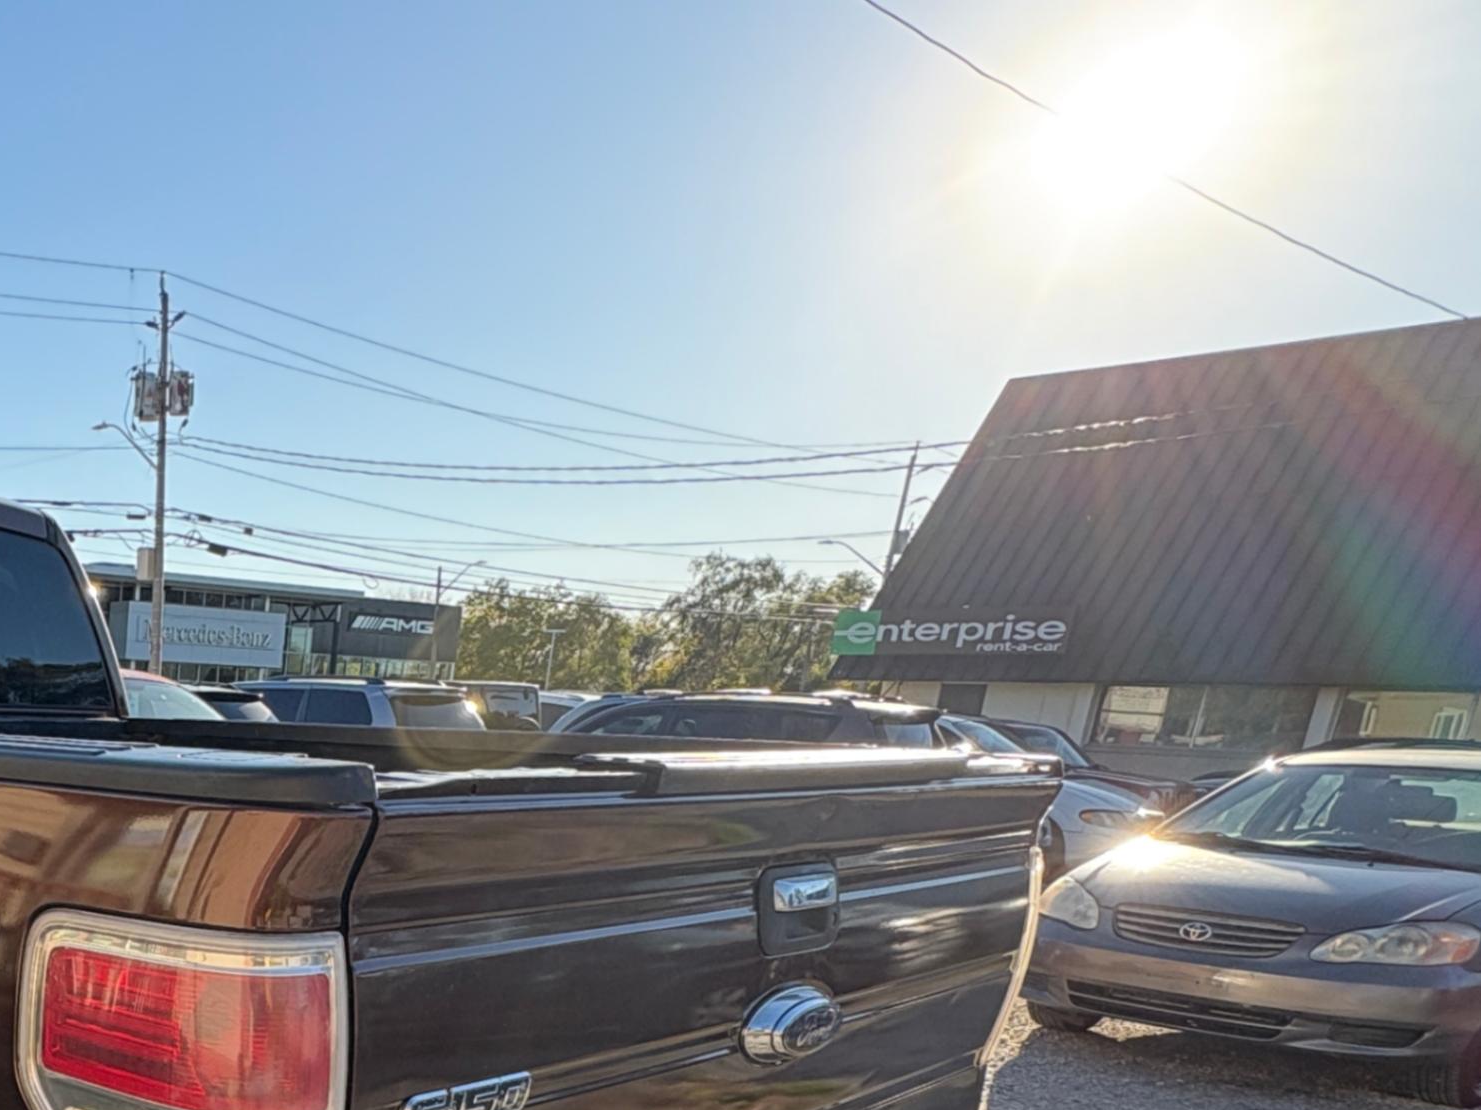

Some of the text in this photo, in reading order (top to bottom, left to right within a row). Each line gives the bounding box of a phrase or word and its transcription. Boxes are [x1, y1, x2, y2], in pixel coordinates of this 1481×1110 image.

[379, 617, 435, 635] AMG
[845, 614, 1067, 648] enterprise
[975, 641, 1062, 652] rent-a-car
